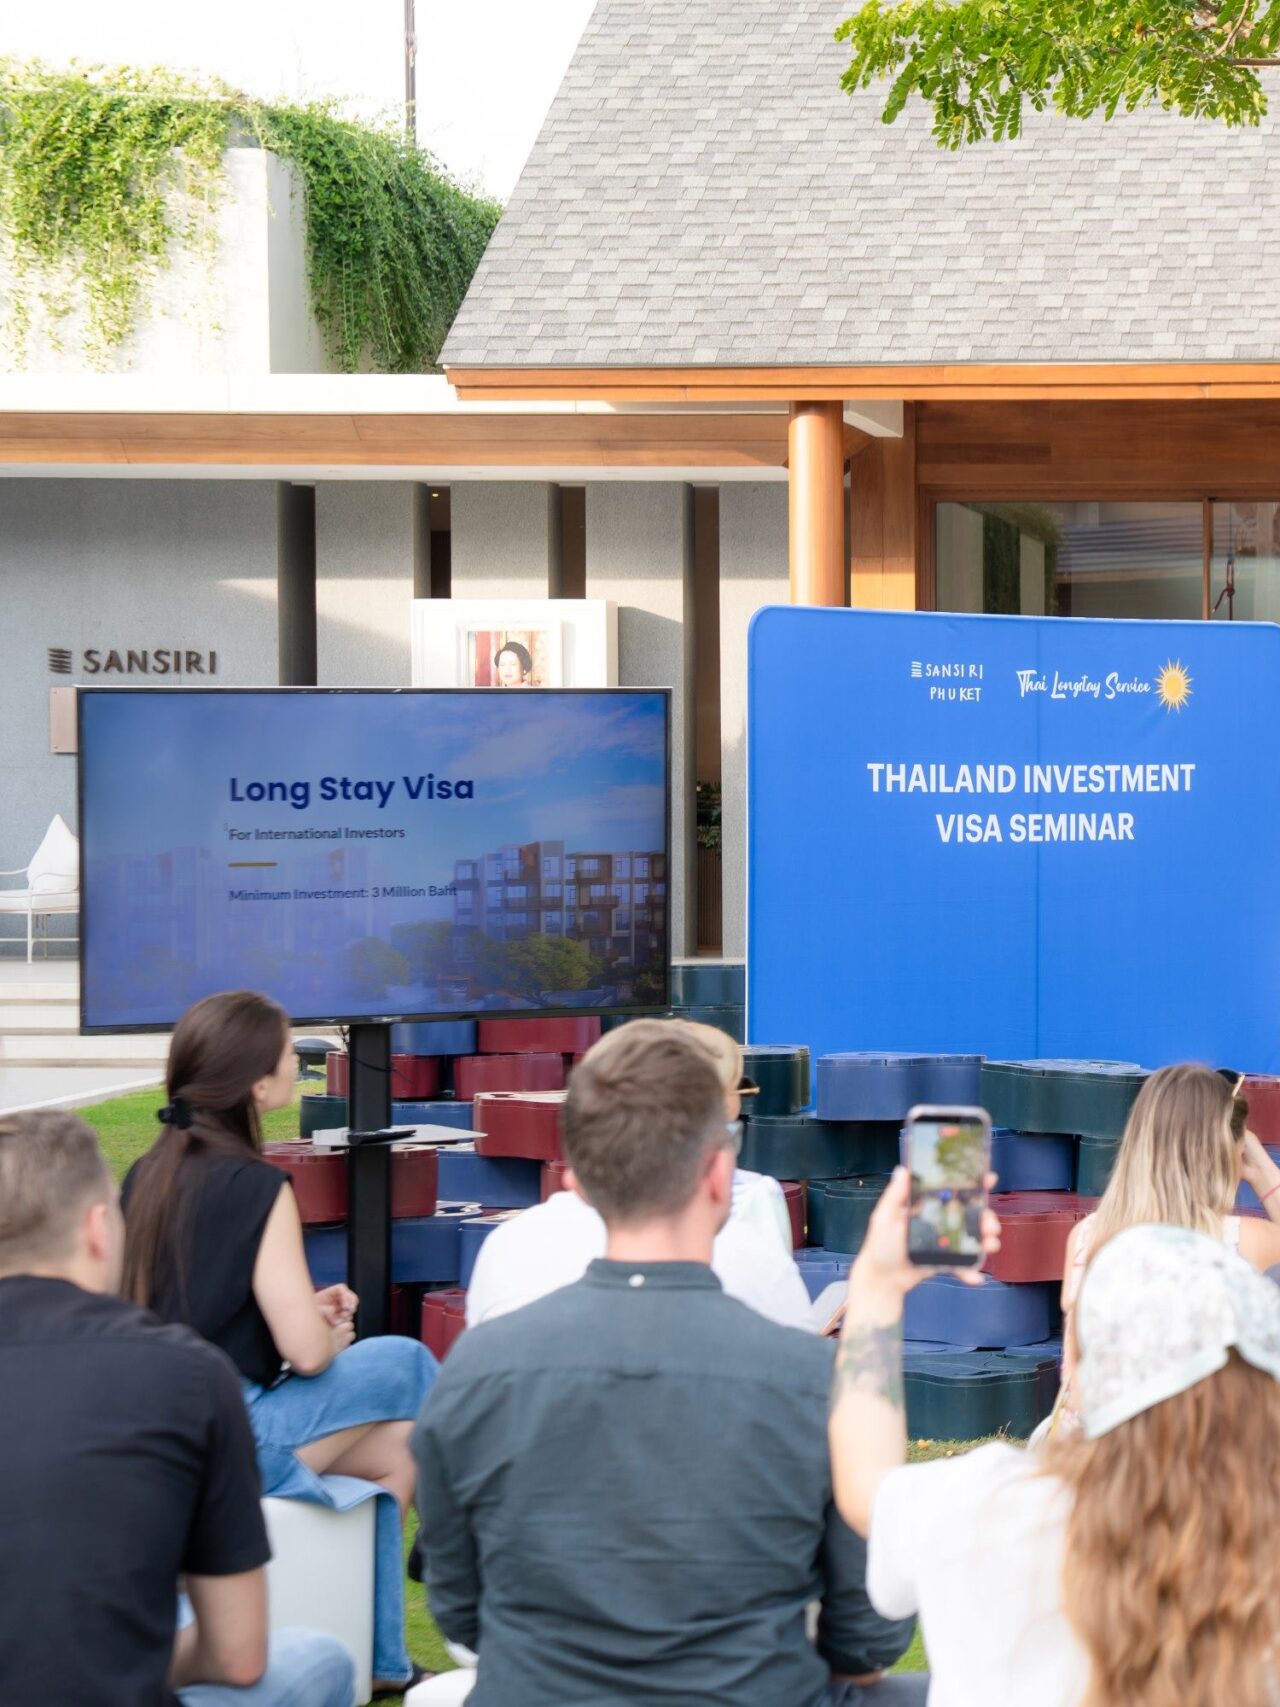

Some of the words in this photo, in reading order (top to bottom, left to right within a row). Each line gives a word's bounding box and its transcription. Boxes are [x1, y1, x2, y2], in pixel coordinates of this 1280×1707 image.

[82, 648, 217, 674] SANSIRI
[926, 663, 983, 680] SANSIRI
[930, 686, 982, 701] PHUKET
[1016, 670, 1047, 697] Thai
[1050, 671, 1101, 699] Longstay
[1105, 672, 1151, 699] Service
[229, 777, 310, 810] Long
[319, 776, 396, 809] Stay
[402, 772, 475, 801] Visa
[867, 763, 1016, 794] THAILAND
[1023, 763, 1196, 794] INVESTMENT
[229, 829, 252, 840] For
[255, 827, 342, 840] International
[345, 827, 405, 840] Investors
[936, 813, 1003, 843] VISA
[1009, 812, 1135, 843] SEMINAR
[229, 889, 290, 901] Minimum
[293, 887, 368, 901] Investment:
[371, 887, 381, 898] 3
[383, 885, 426, 898] Million
[429, 884, 458, 897] Baht
